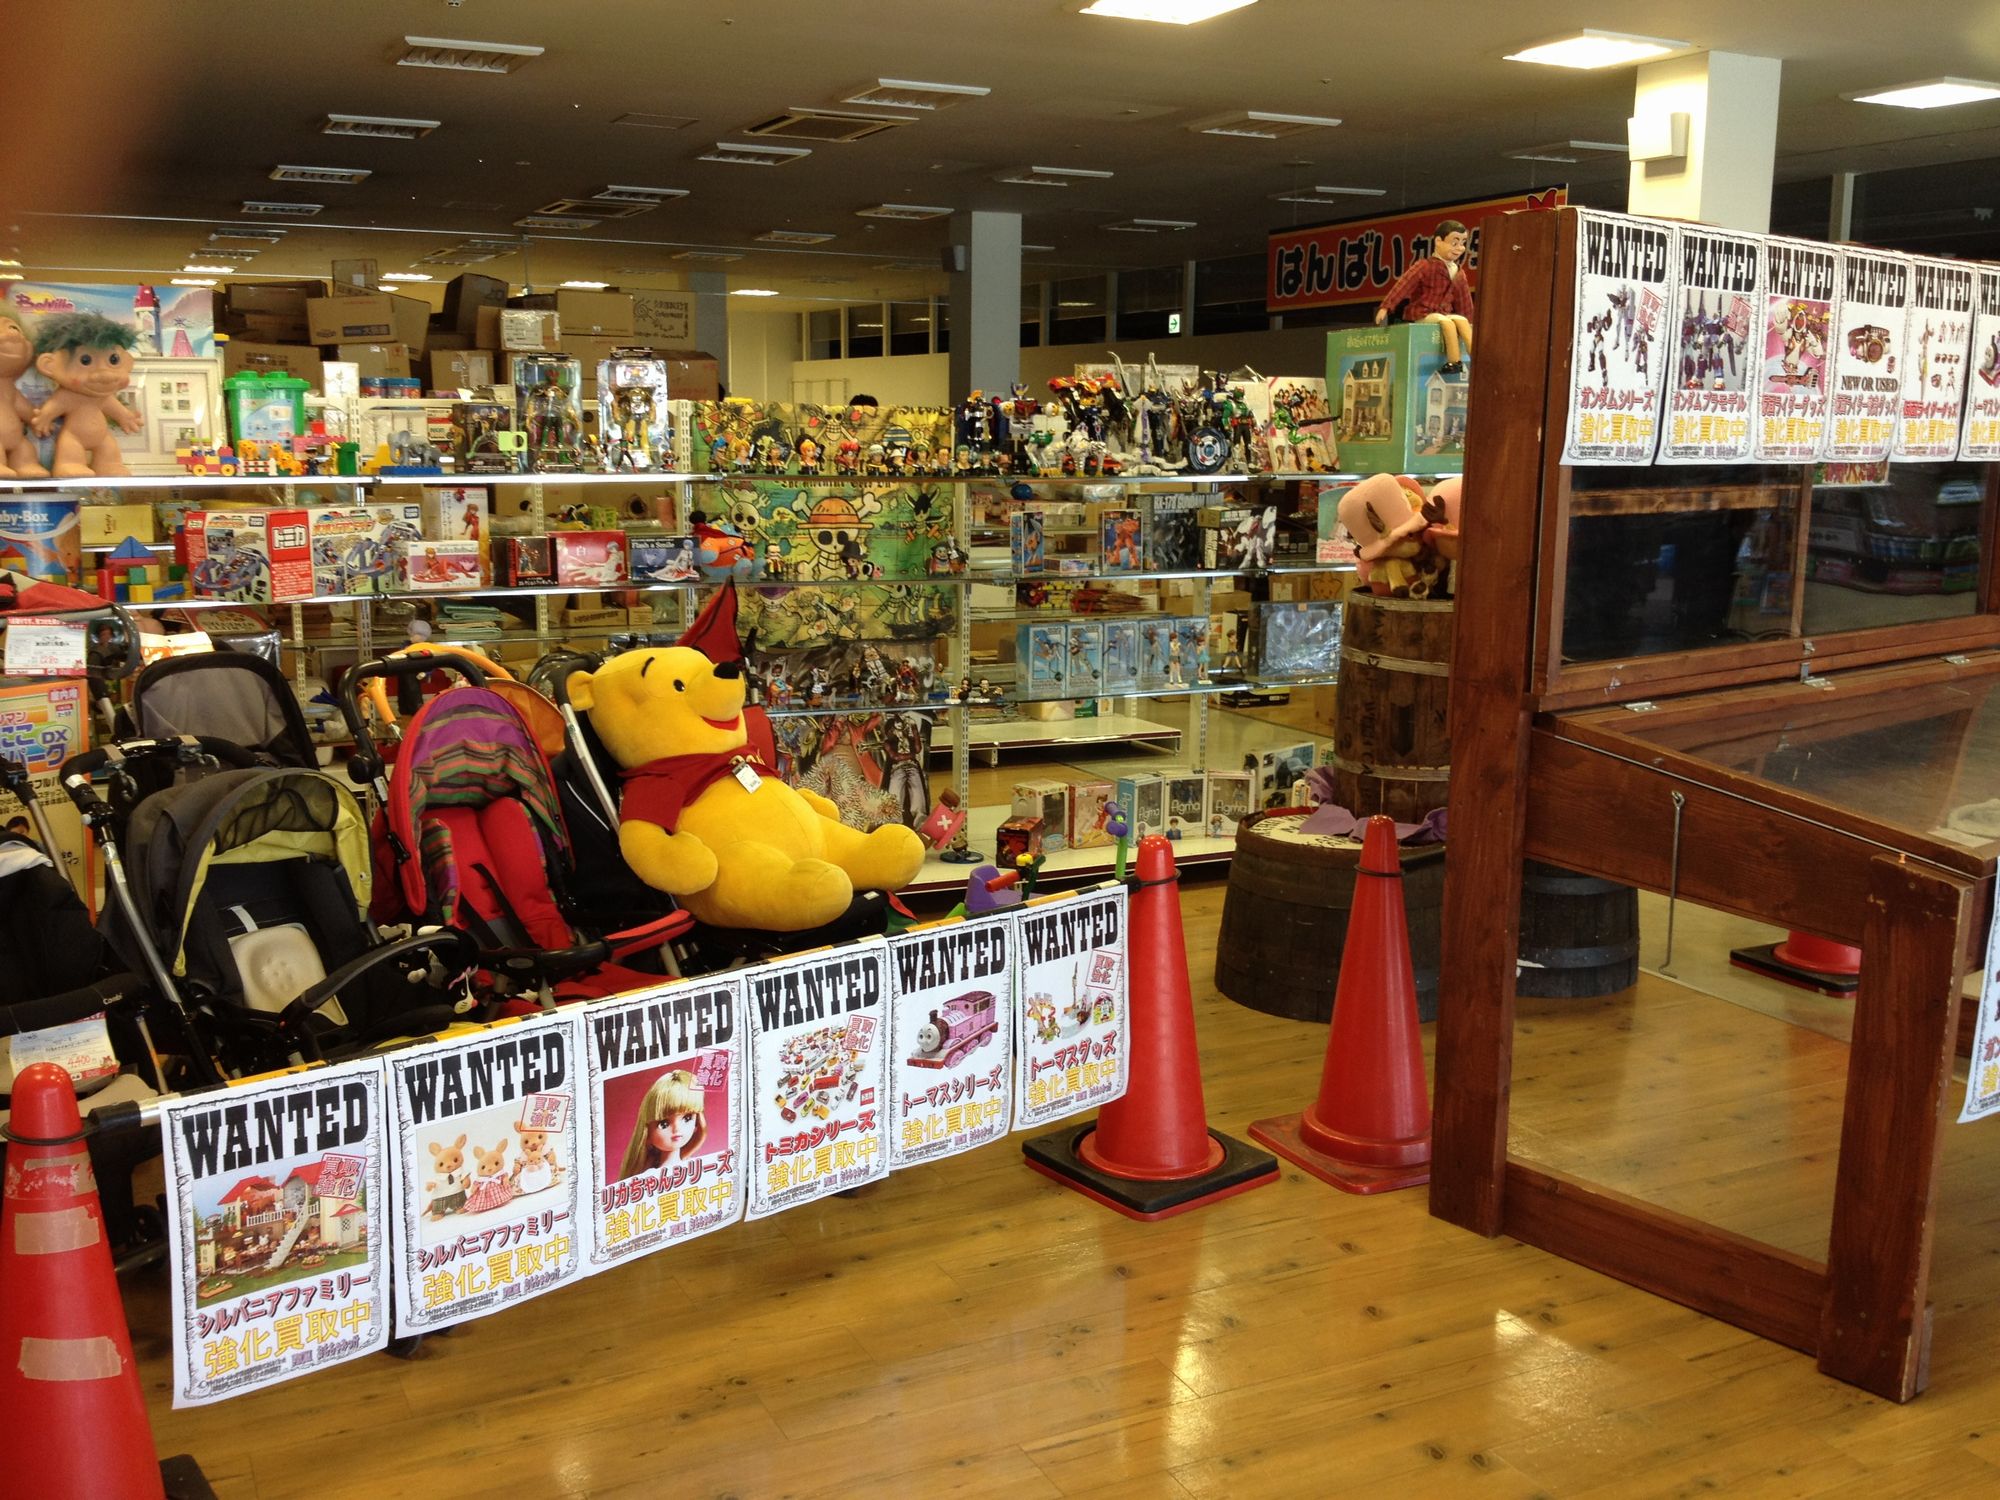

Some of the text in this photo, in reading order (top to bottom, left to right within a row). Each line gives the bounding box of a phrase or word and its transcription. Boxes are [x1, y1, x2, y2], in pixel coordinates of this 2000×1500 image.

[1275, 229, 1403, 298] はんばい
[1586, 221, 1668, 283] WANTED
[1683, 235, 1757, 292] WANTED
[1768, 245, 1834, 301] WANTED
[1846, 256, 1907, 308] WANTED
[1915, 264, 1972, 313] WANTED
[1580, 386, 1655, 412] ガンダムシリーズ
[1841, 375, 1898, 392] NEW OR USED
[1579, 413, 1654, 445] 強化買取中
[1672, 415, 1747, 445] 強化買取中
[1763, 417, 1823, 445] 強化買取中
[1835, 418, 1894, 445] 強化買取中
[272, 525, 307, 550] トミカ
[2, 743, 66, 768] パーク
[41, 728, 68, 744] DX
[1139, 806, 1160, 822] figma
[1171, 799, 1201, 815] figma
[1215, 799, 1247, 815] figma
[1024, 900, 1118, 967] WANTED
[897, 926, 1005, 995] WANTED
[755, 956, 880, 1032] WANTED
[594, 989, 733, 1072] WANTED
[1030, 1030, 1118, 1081] トーマスグッズ
[404, 1032, 565, 1125] WANTED
[699, 1053, 729, 1070] 買取
[1028, 1056, 1117, 1109] 強化買取中
[534, 1096, 562, 1113] 買取
[902, 1064, 1002, 1117] トーマスシリーズ
[181, 1082, 368, 1180] WANTED
[529, 1111, 557, 1128] 強化
[765, 1109, 876, 1164] トミカシリーズ
[902, 1095, 1002, 1149] 強化買取中
[315, 1174, 356, 1197] 強化
[321, 1156, 361, 1177] 買取
[601, 1150, 733, 1214] リカちゃんシリーズ
[767, 1133, 878, 1195] 強化買取中
[605, 1178, 733, 1247] 強化買取中
[423, 1233, 571, 1310] 強化買取中
[203, 1298, 371, 1380] 強化買取中
